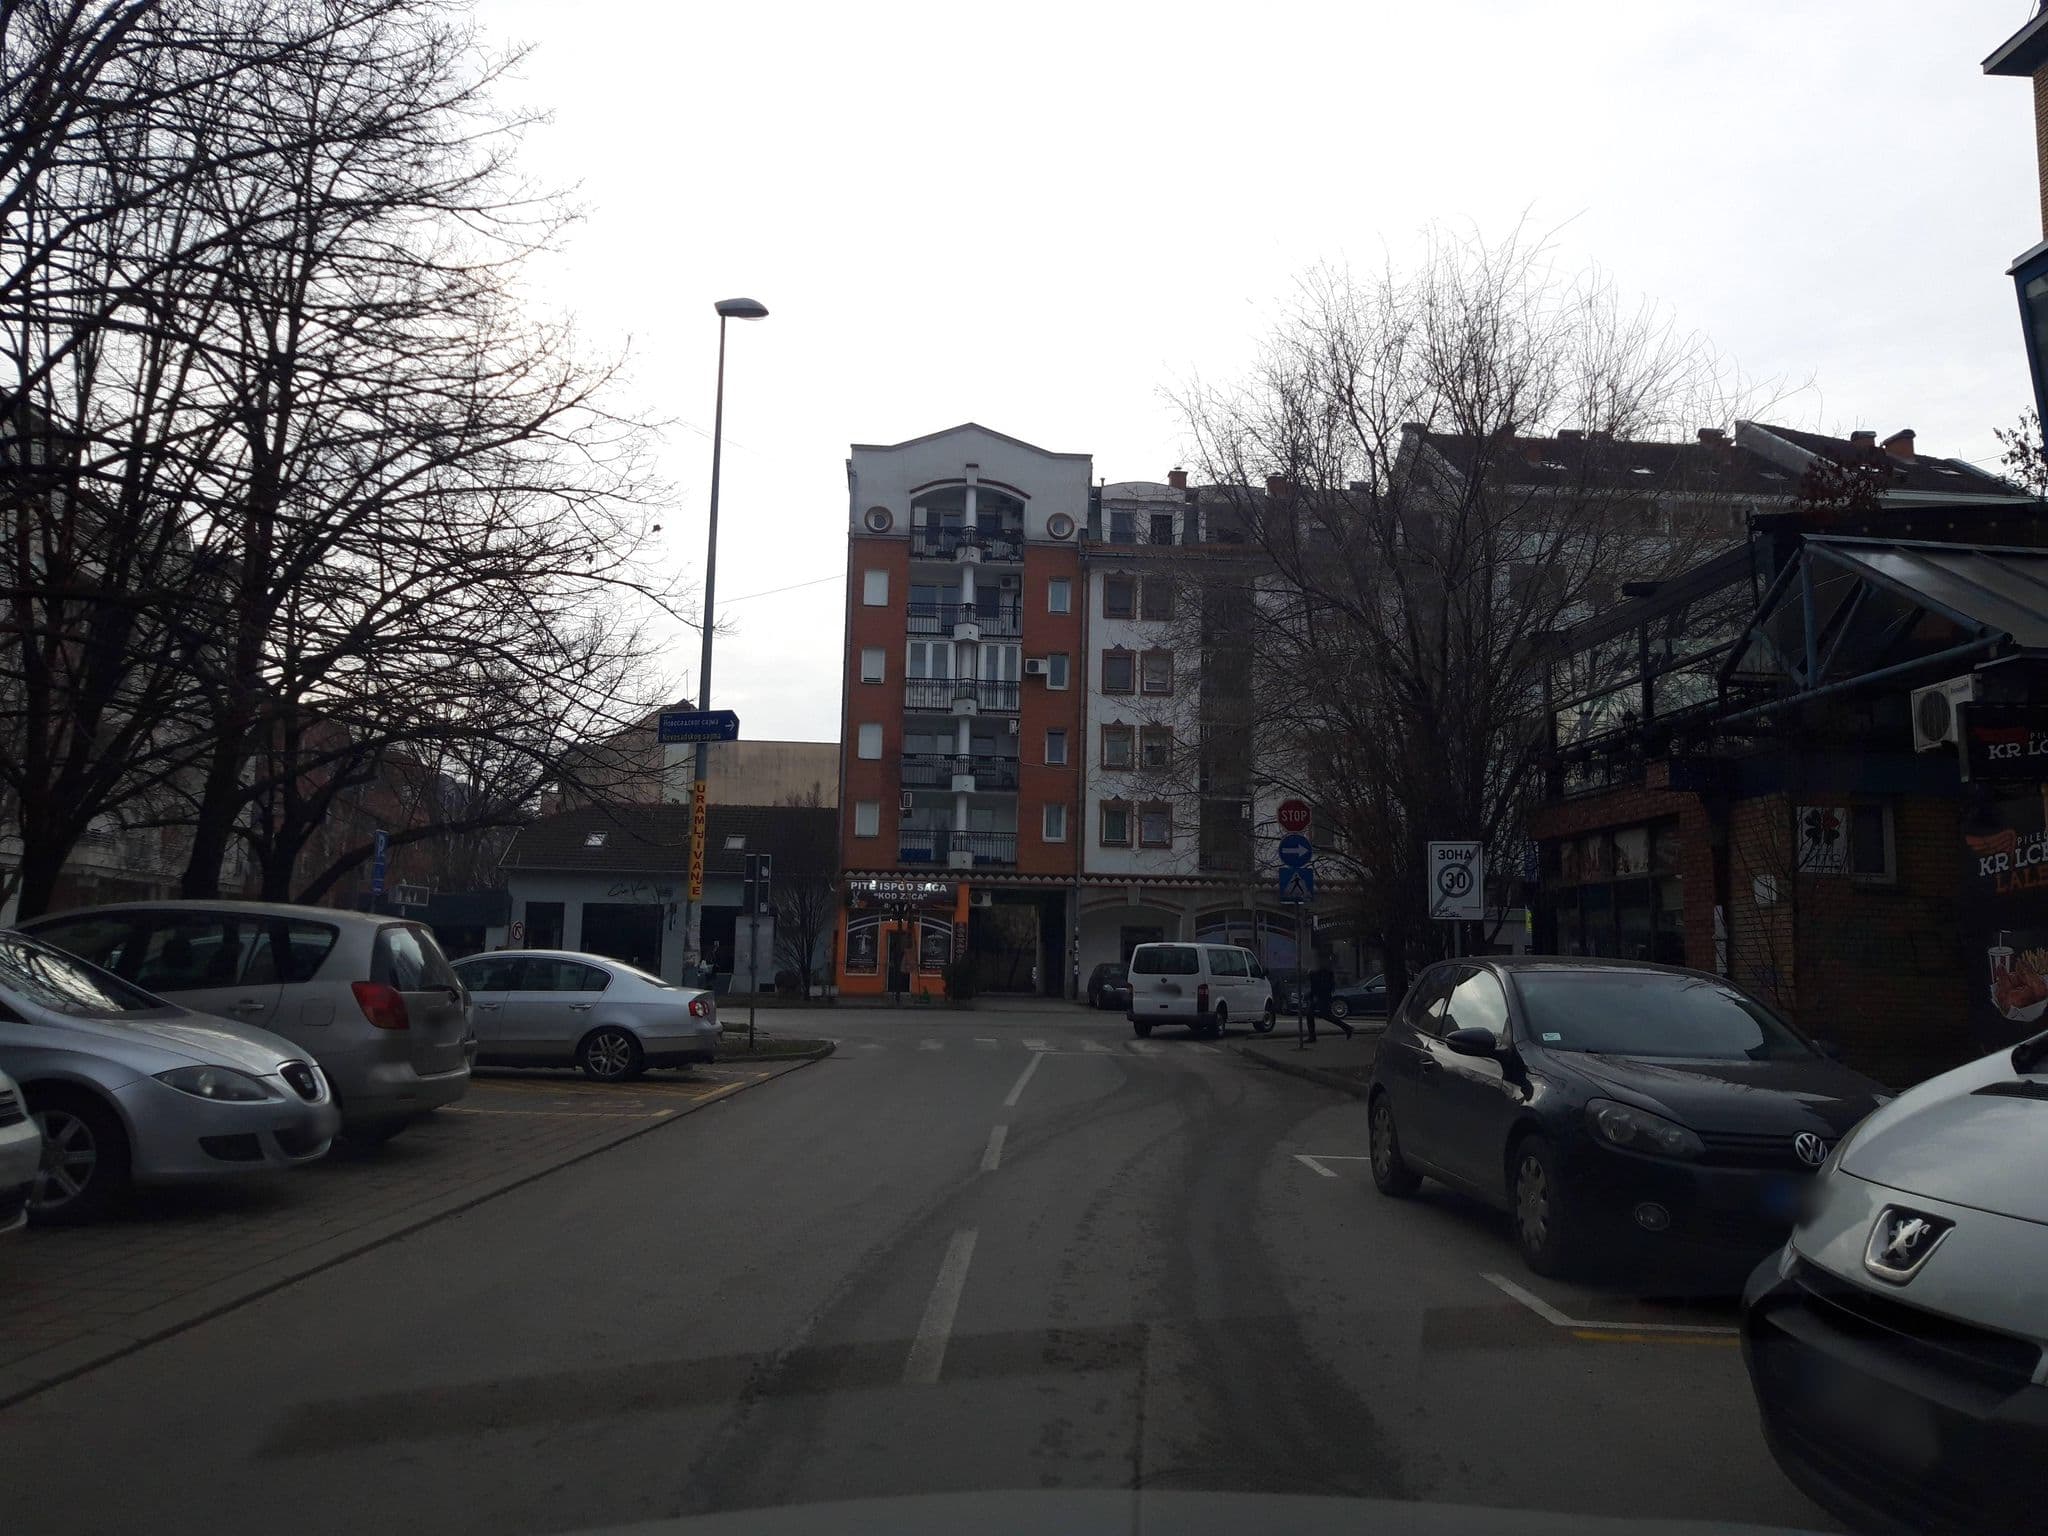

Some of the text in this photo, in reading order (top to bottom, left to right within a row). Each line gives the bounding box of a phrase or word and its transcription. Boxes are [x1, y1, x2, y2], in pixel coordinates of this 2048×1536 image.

[1281, 809, 1308, 822] STOP
[1438, 849, 1472, 860] ЗОНА
[1446, 872, 1466, 889] 30
[850, 882, 877, 891] PITE
[880, 882, 914, 892] ISPOD
